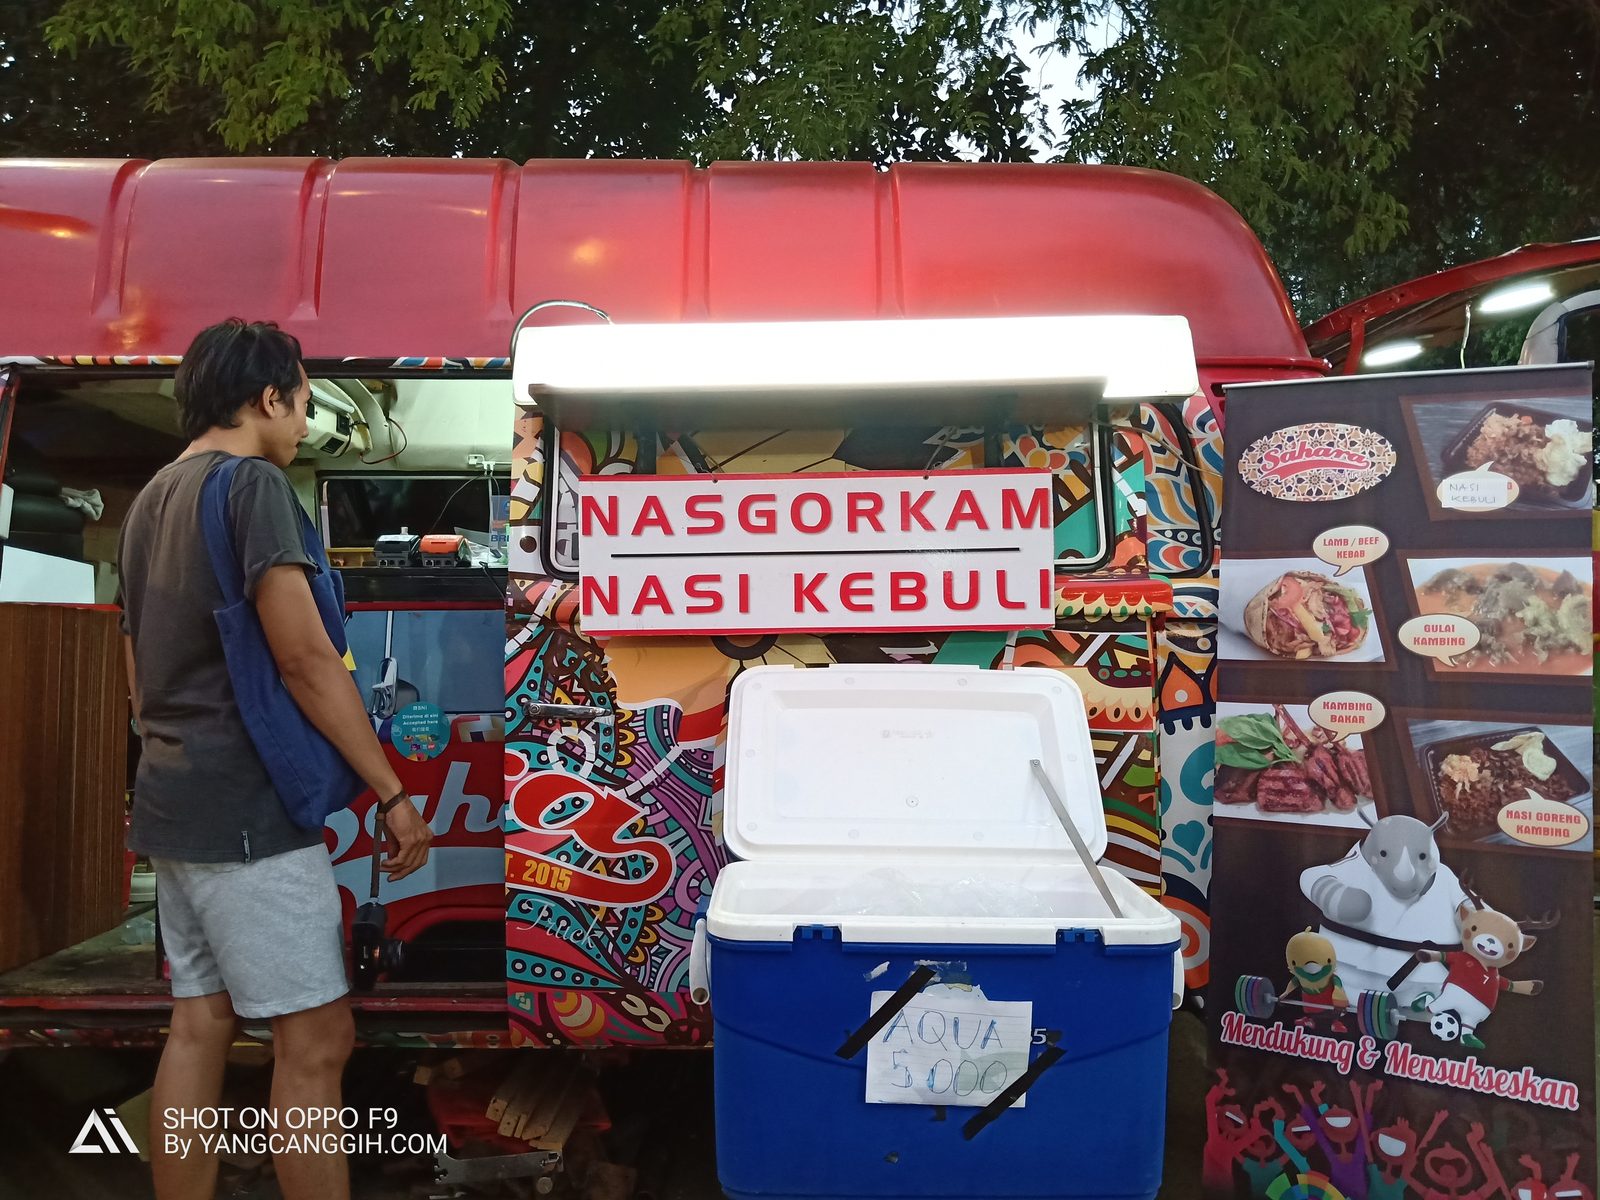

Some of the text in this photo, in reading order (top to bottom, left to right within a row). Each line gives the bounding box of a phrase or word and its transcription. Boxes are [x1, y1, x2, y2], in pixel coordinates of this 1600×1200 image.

[1260, 440, 1368, 473] Sahara
[1449, 483, 1479, 492] NASI
[1451, 495, 1496, 504] KEBULI
[582, 487, 1051, 536] NASGORKAM
[1323, 538, 1349, 547] LAMB
[1358, 536, 1380, 546] BEEF
[1337, 550, 1366, 559] KEBAB
[582, 568, 1051, 616] NASI KEBULI
[1423, 624, 1456, 633] GULAI
[1413, 636, 1466, 646] KAMBING
[1323, 701, 1373, 711] KAMBING
[1330, 714, 1366, 724] BAKAR
[1506, 810, 1581, 824] NASI GORENG
[1516, 825, 1570, 838] KAMBING
[522, 859, 574, 893] 2015
[516, 898, 606, 950] Truck
[883, 1008, 1003, 1052] AQUA
[1221, 1012, 1580, 1111] Mendukung & Mensukseskan
